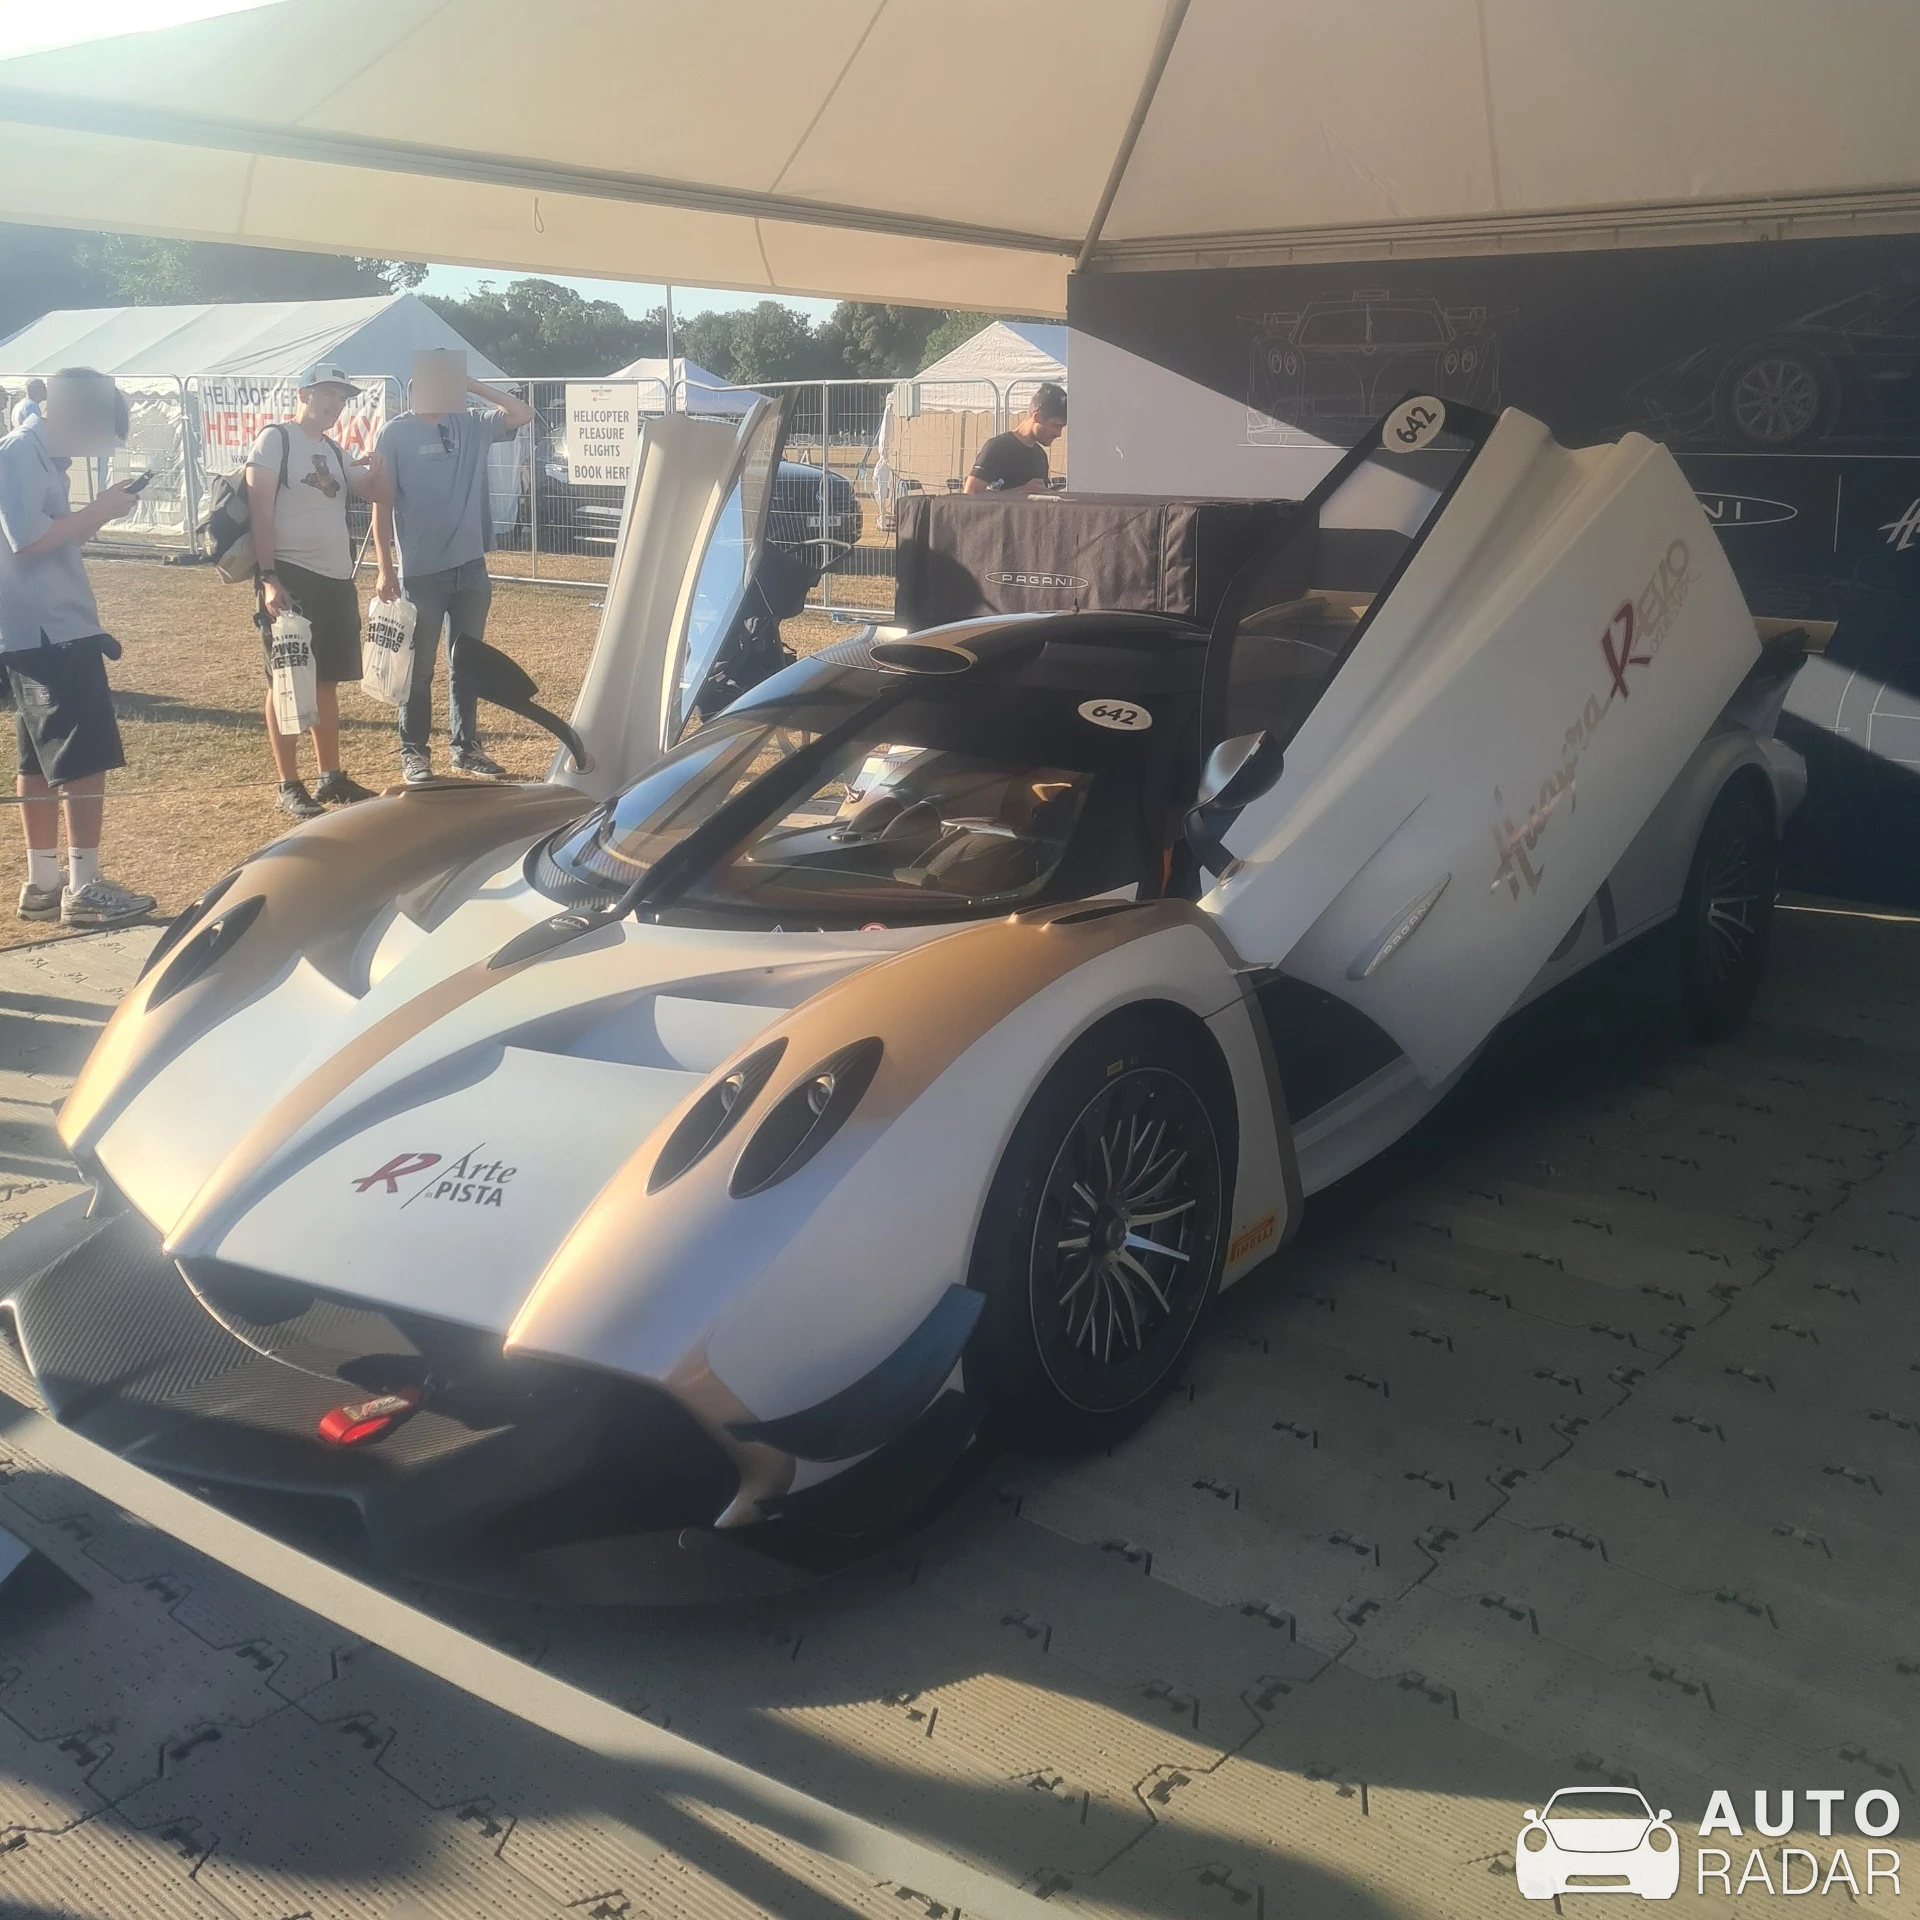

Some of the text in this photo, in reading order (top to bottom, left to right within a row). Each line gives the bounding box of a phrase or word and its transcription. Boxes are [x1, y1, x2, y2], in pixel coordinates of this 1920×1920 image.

[573, 410, 630, 423] HELICOPTER
[1396, 406, 1437, 443] 642
[579, 427, 625, 440] PLEASURE
[584, 444, 621, 457] FLIGHTS
[574, 465, 603, 479] BOOK
[1002, 574, 1073, 587] PAGANI
[1091, 704, 1138, 726] 642
[1383, 901, 1431, 955] PAGANI
[351, 1152, 442, 1194] R
[451, 1152, 518, 1184] Arte
[434, 1180, 504, 1208] PISTA
[1229, 1215, 1275, 1264] PIRELLI
